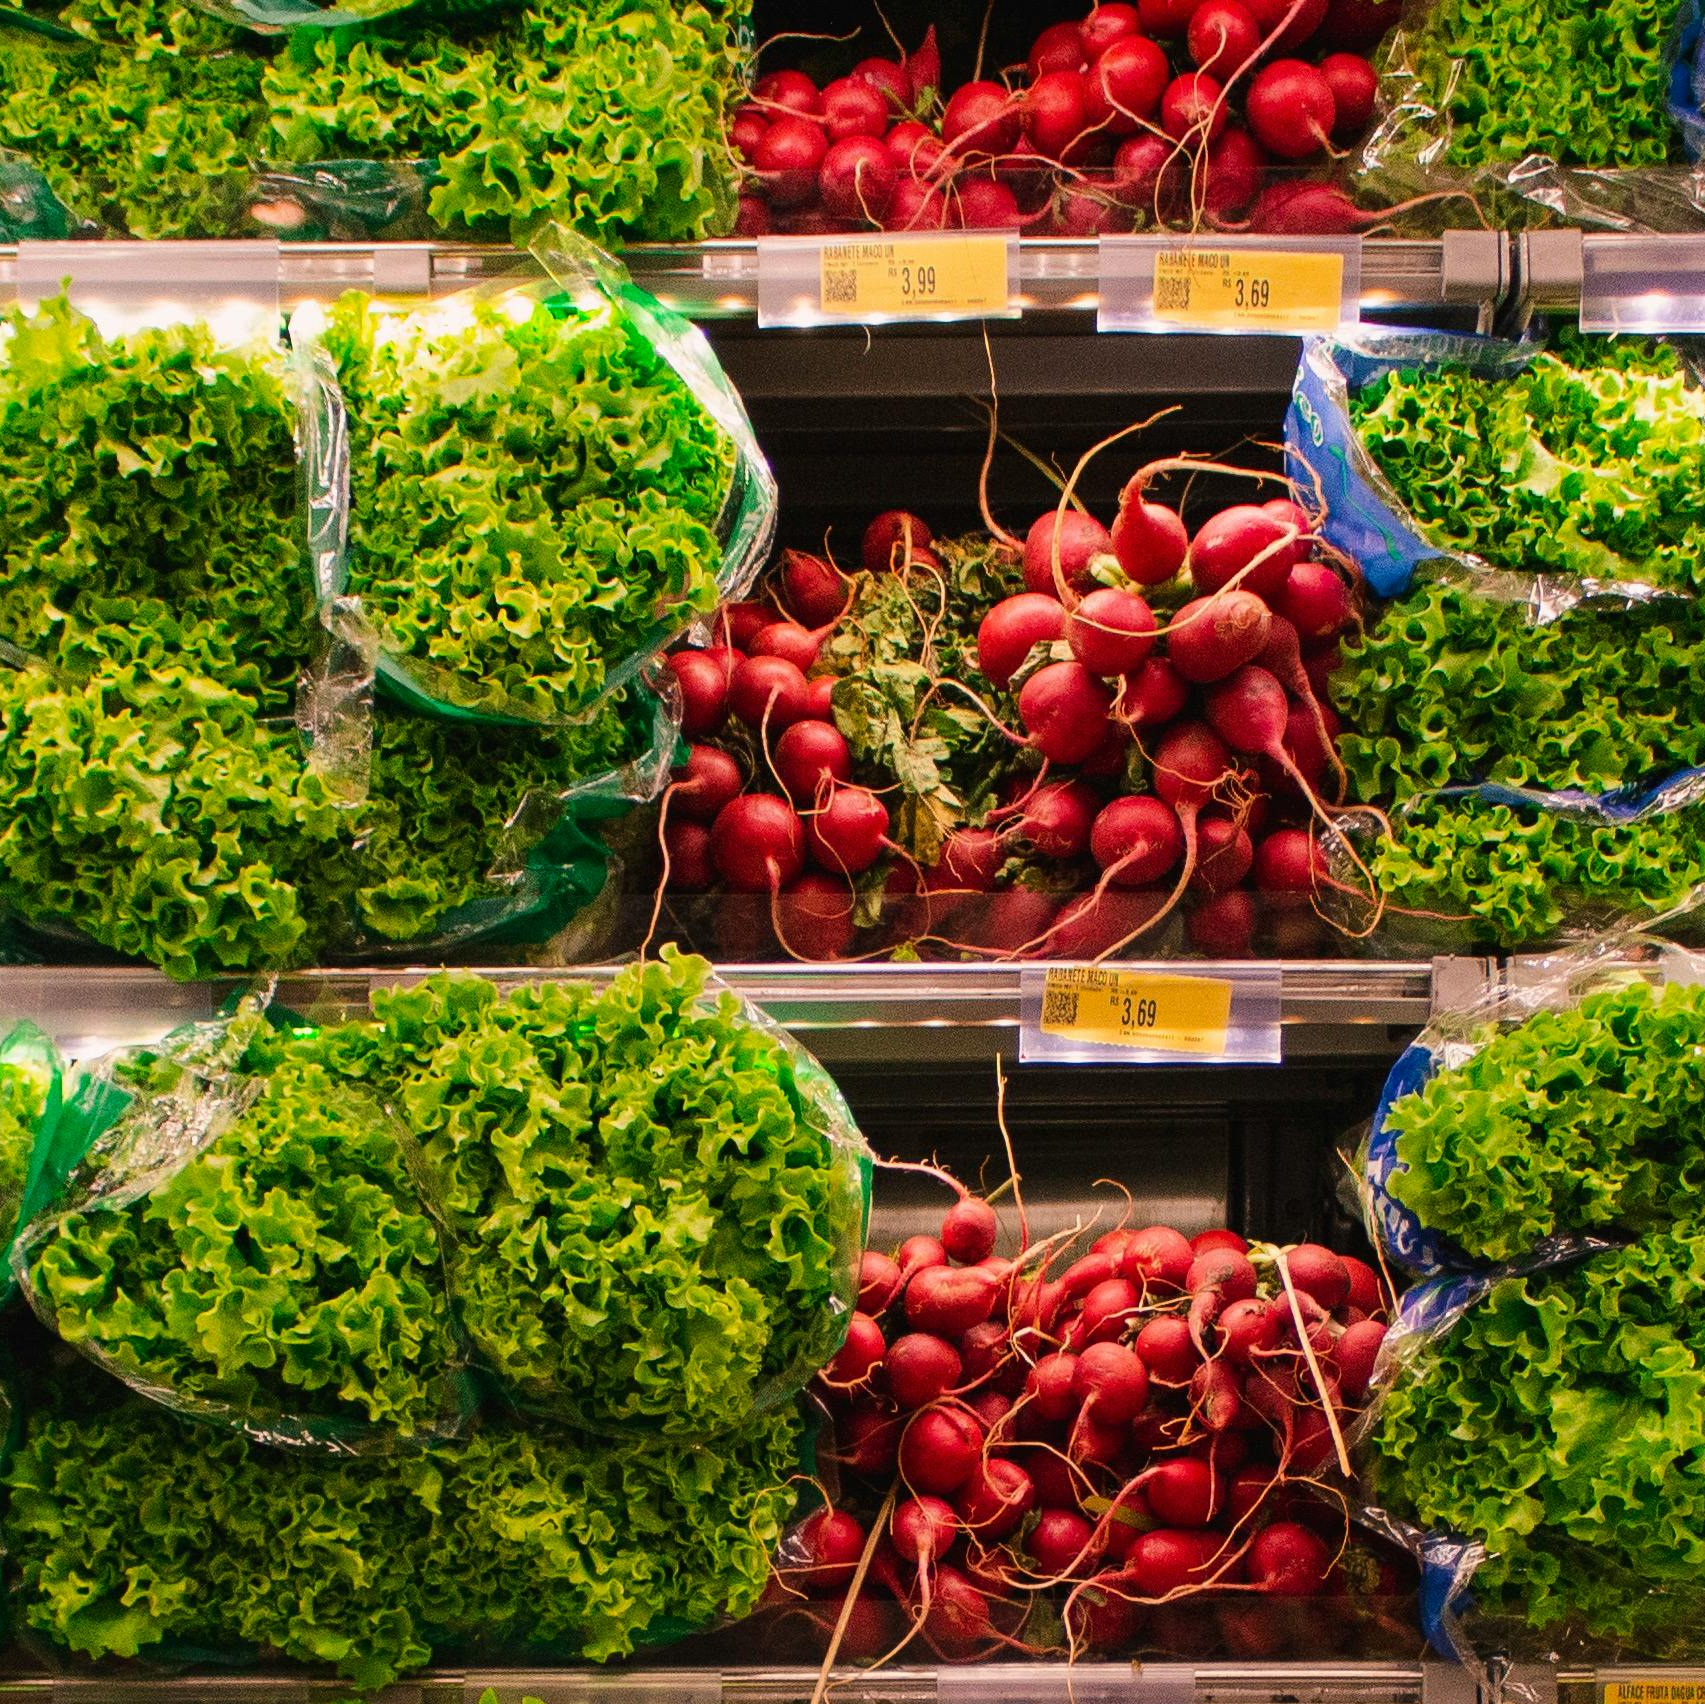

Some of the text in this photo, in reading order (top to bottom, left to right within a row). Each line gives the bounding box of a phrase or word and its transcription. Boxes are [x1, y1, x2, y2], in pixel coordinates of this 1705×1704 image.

[901, 265, 936, 298] 3,99
[1234, 279, 1270, 311] 3,69
[1121, 998, 1157, 1029] 3,69
